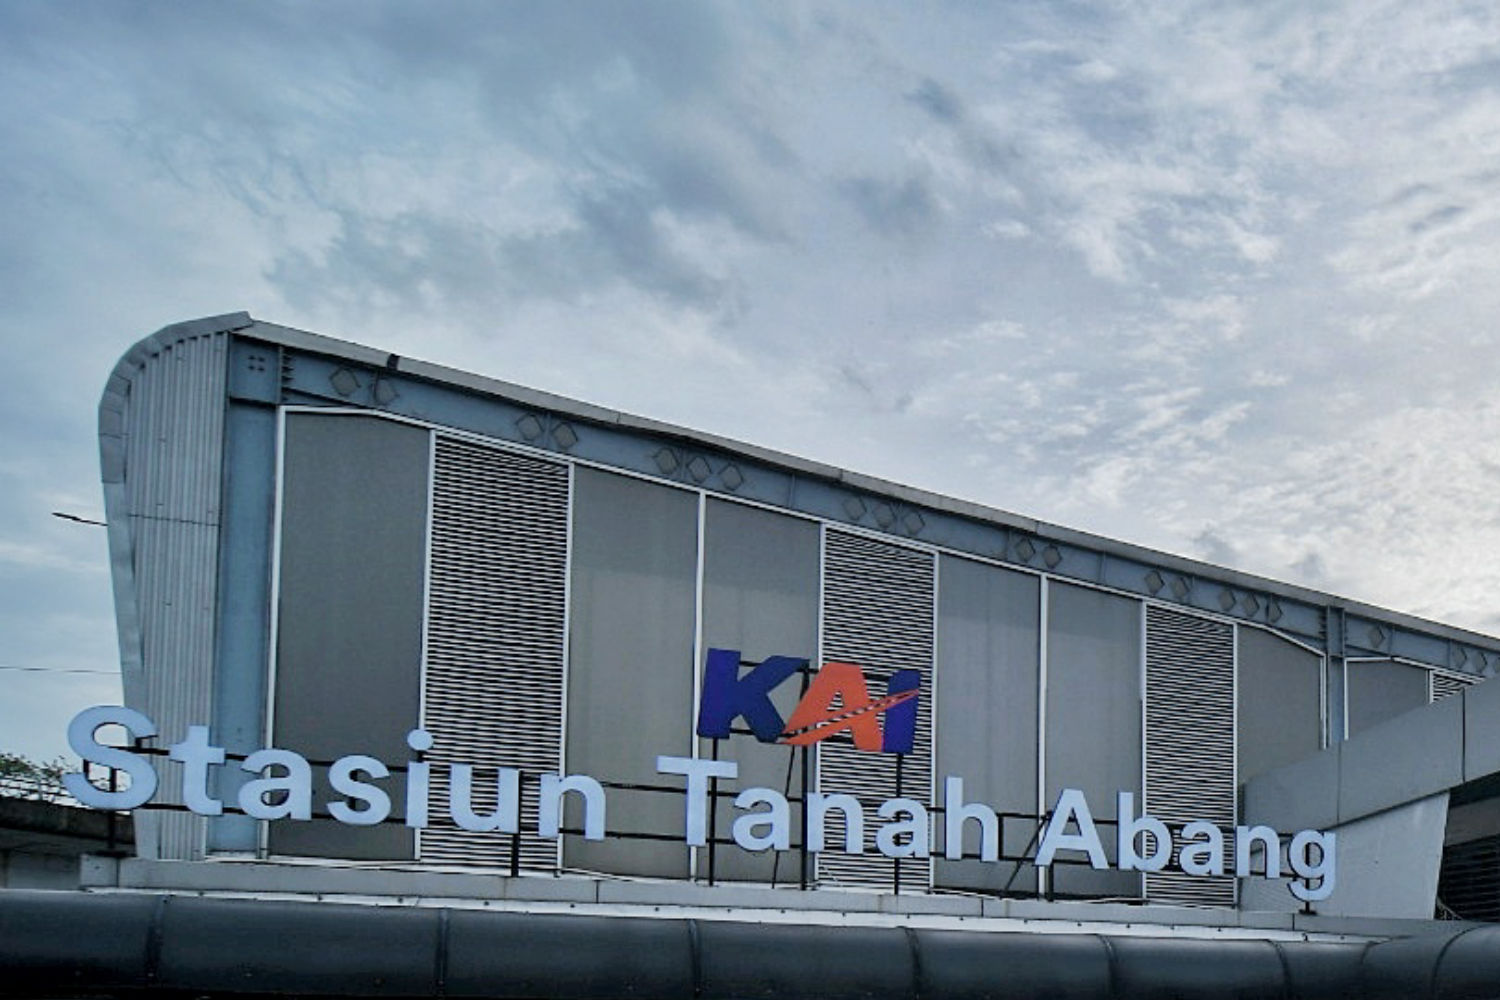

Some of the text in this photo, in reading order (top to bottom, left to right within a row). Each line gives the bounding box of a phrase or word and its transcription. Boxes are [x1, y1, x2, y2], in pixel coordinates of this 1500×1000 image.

[697, 648, 922, 754] KAI
[62, 704, 1339, 901] Stasiun Tanah Abang
